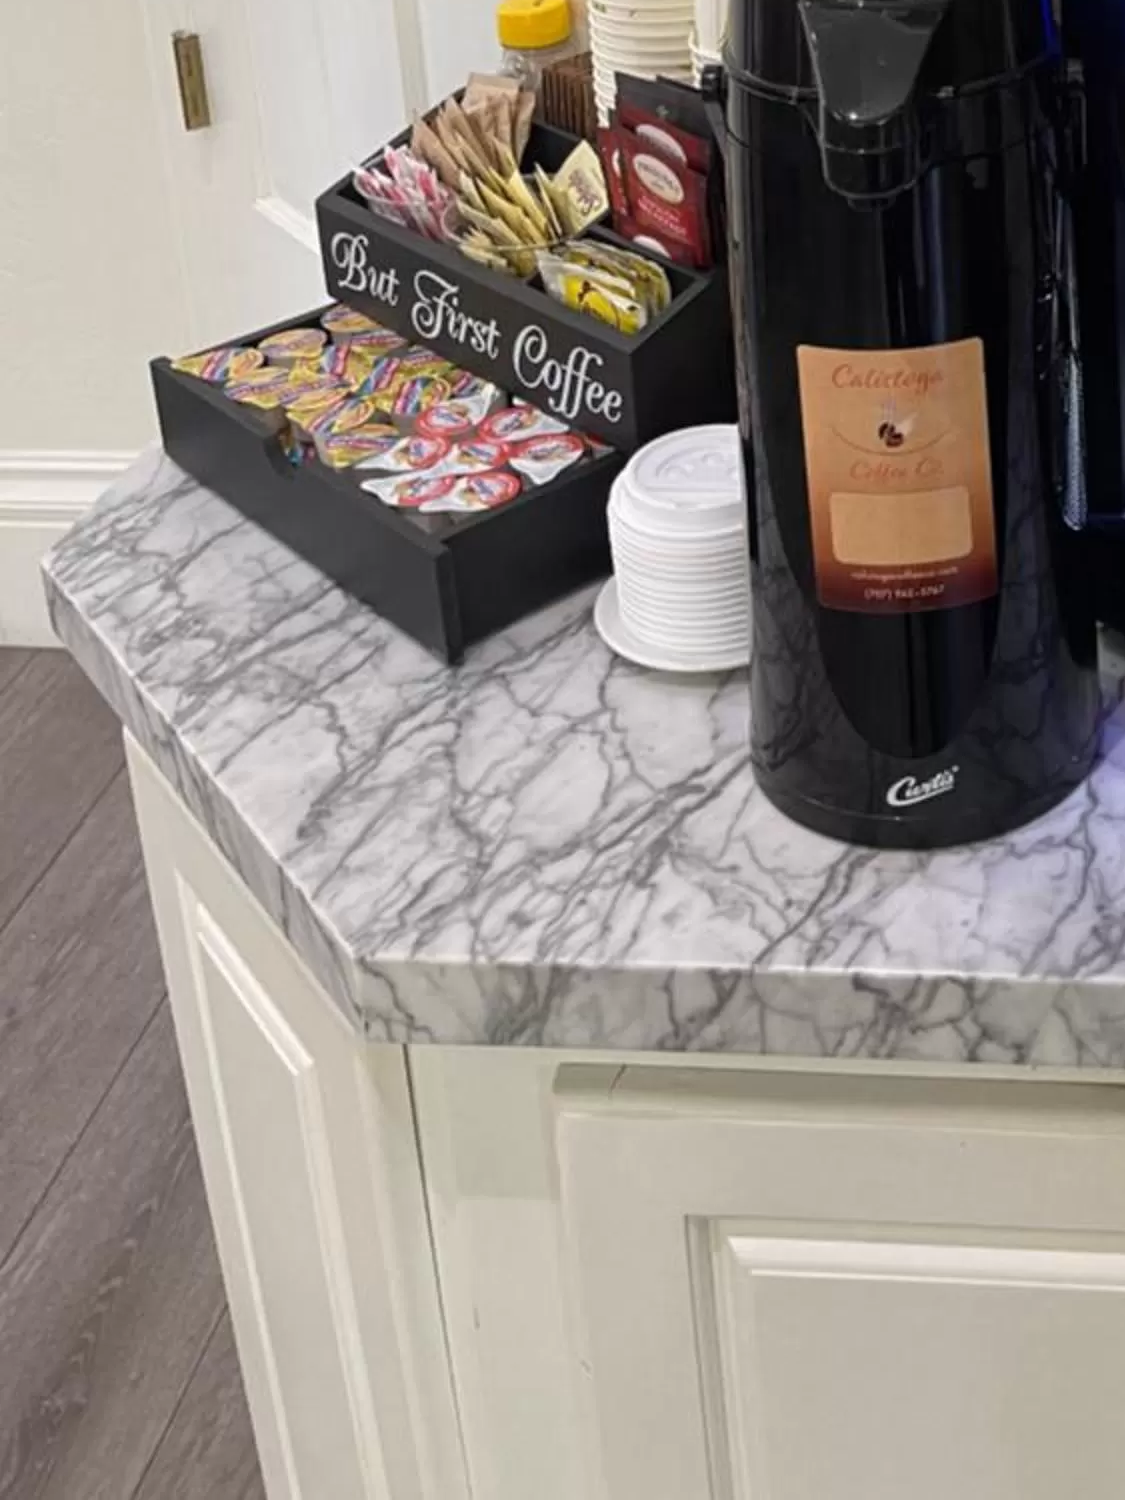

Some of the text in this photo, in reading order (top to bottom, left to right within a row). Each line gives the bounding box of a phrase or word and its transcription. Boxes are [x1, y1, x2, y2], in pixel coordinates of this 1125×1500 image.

[331, 232, 623, 423] But First Coffee
